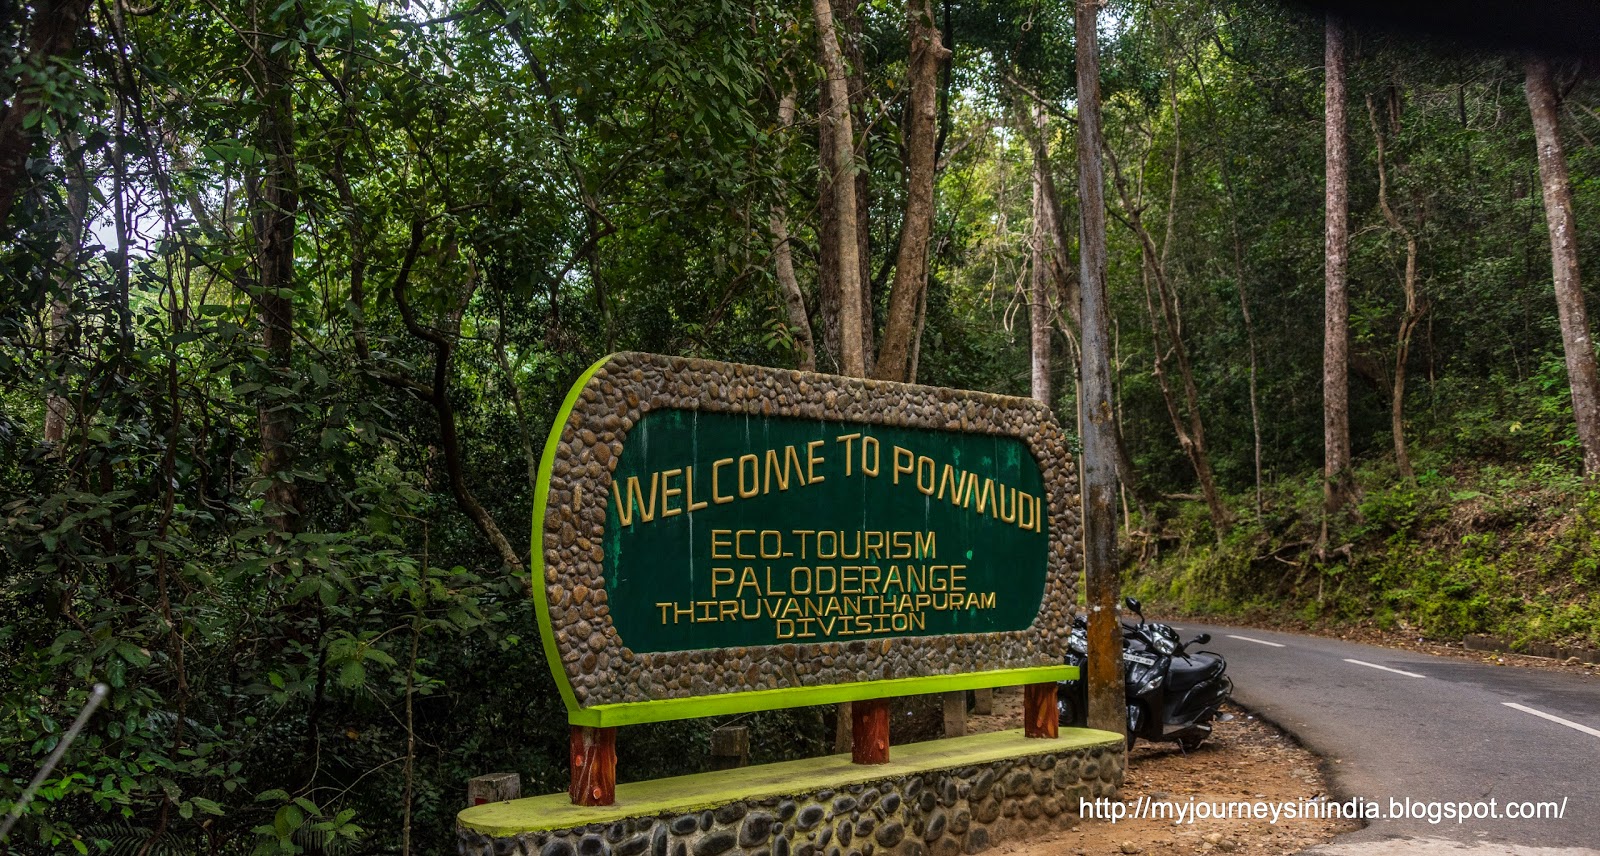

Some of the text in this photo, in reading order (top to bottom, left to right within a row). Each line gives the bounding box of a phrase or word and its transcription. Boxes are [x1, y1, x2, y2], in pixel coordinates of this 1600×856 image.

[611, 432, 1042, 533] WELCOME TO PONMUDI
[655, 591, 996, 625] THIRUVANANTHAPURAM
[776, 611, 926, 640] DIVISION
